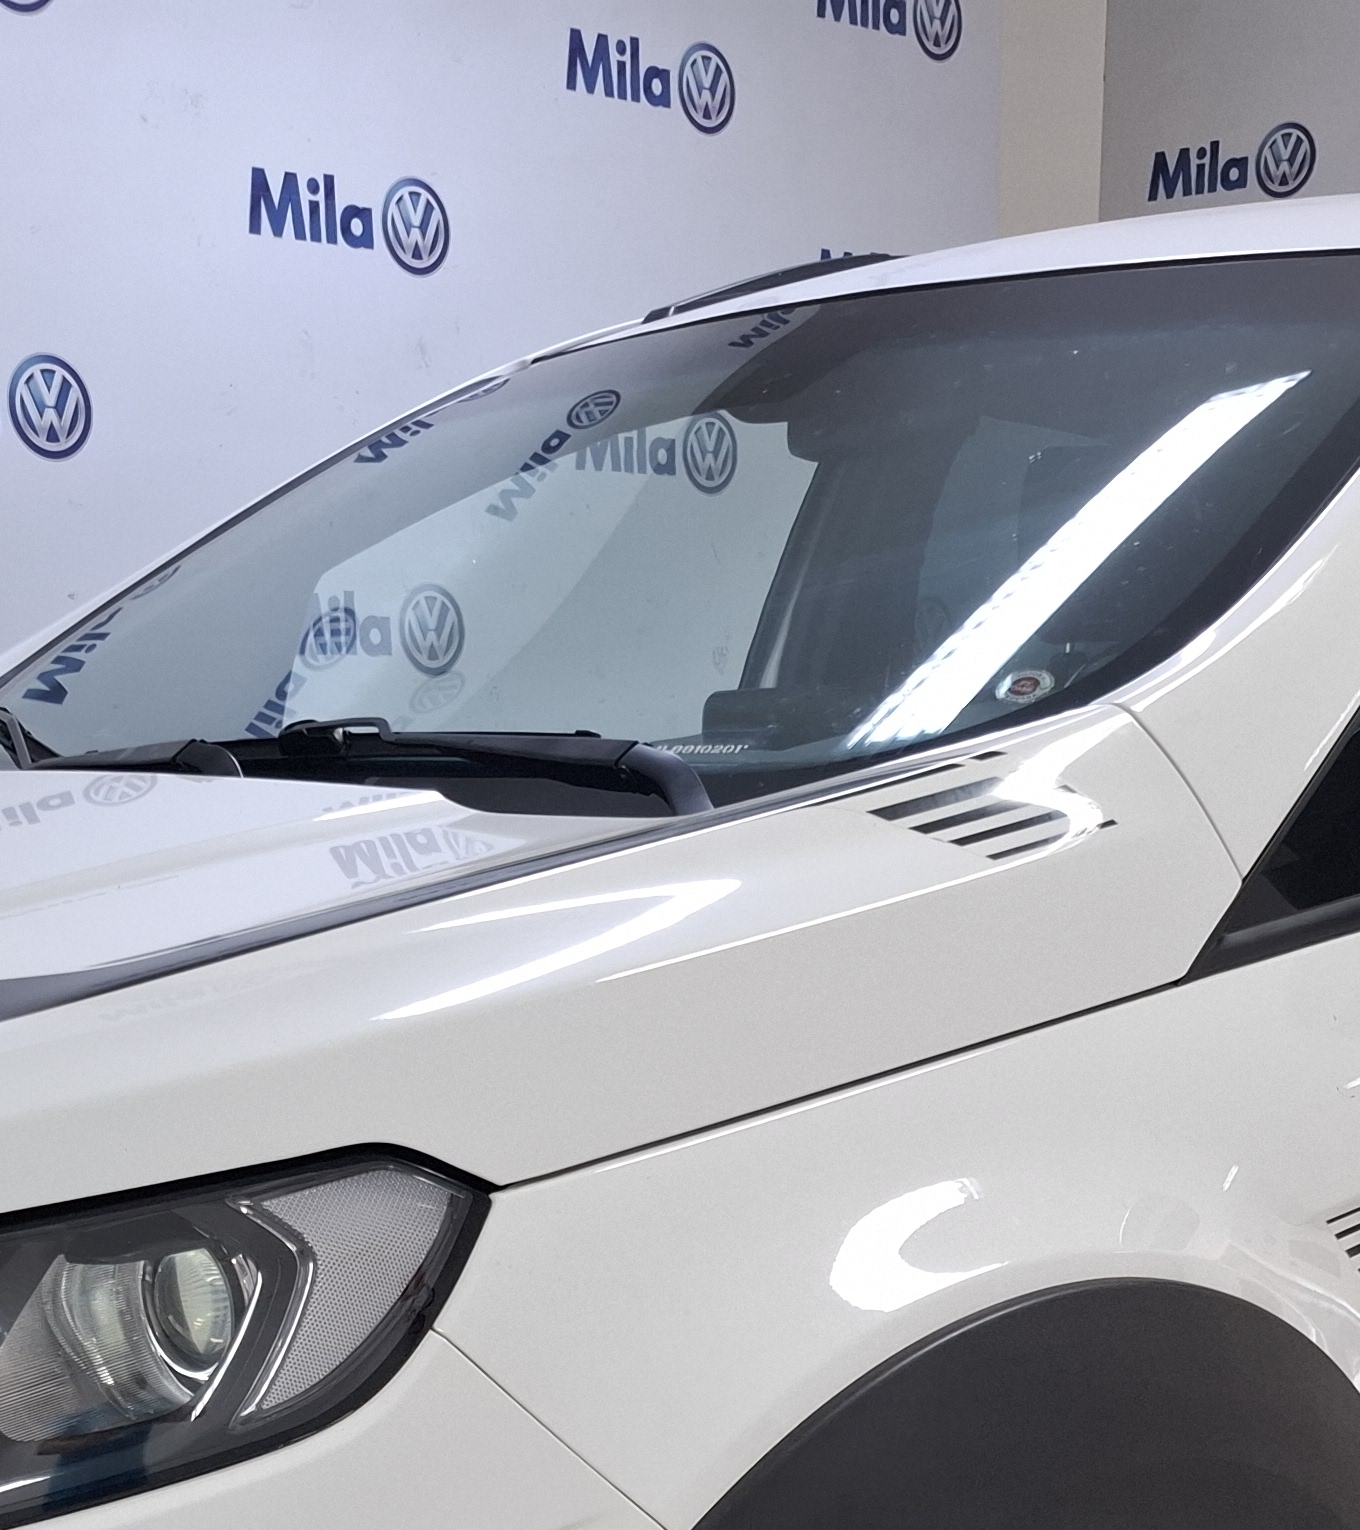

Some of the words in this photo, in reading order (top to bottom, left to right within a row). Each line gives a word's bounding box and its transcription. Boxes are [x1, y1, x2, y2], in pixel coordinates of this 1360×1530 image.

[566, 27, 672, 109] Mila
[1146, 139, 1250, 203] Mila
[248, 166, 374, 250] Mila
[575, 427, 676, 477] Mila
